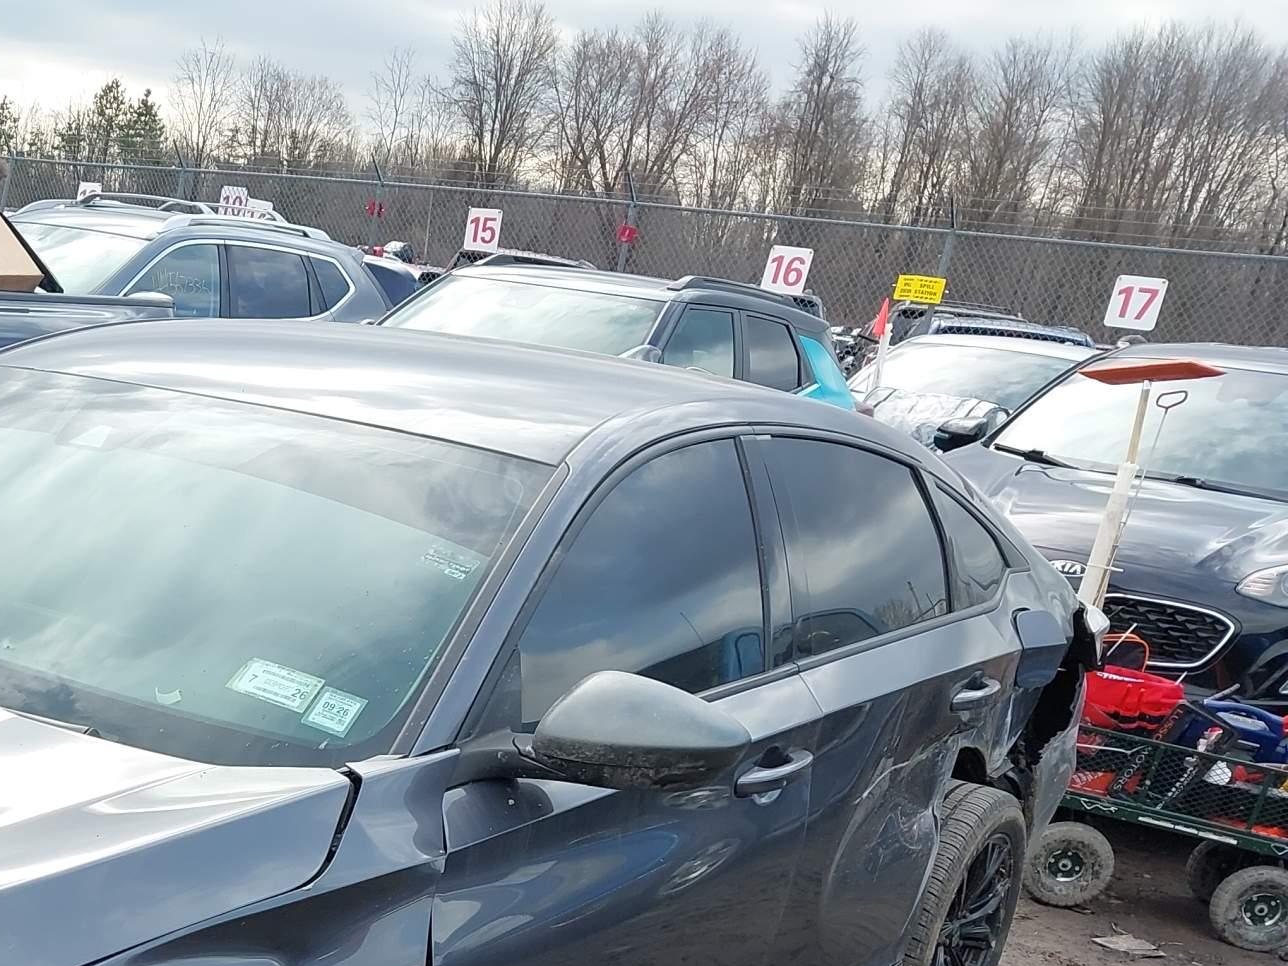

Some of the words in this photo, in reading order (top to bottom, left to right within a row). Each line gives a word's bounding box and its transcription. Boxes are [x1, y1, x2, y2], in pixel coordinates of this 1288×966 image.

[469, 216, 498, 245] 15
[770, 255, 806, 287] 16
[1117, 286, 1160, 321] 17
[1050, 560, 1082, 575] KIA
[291, 687, 310, 701] 26
